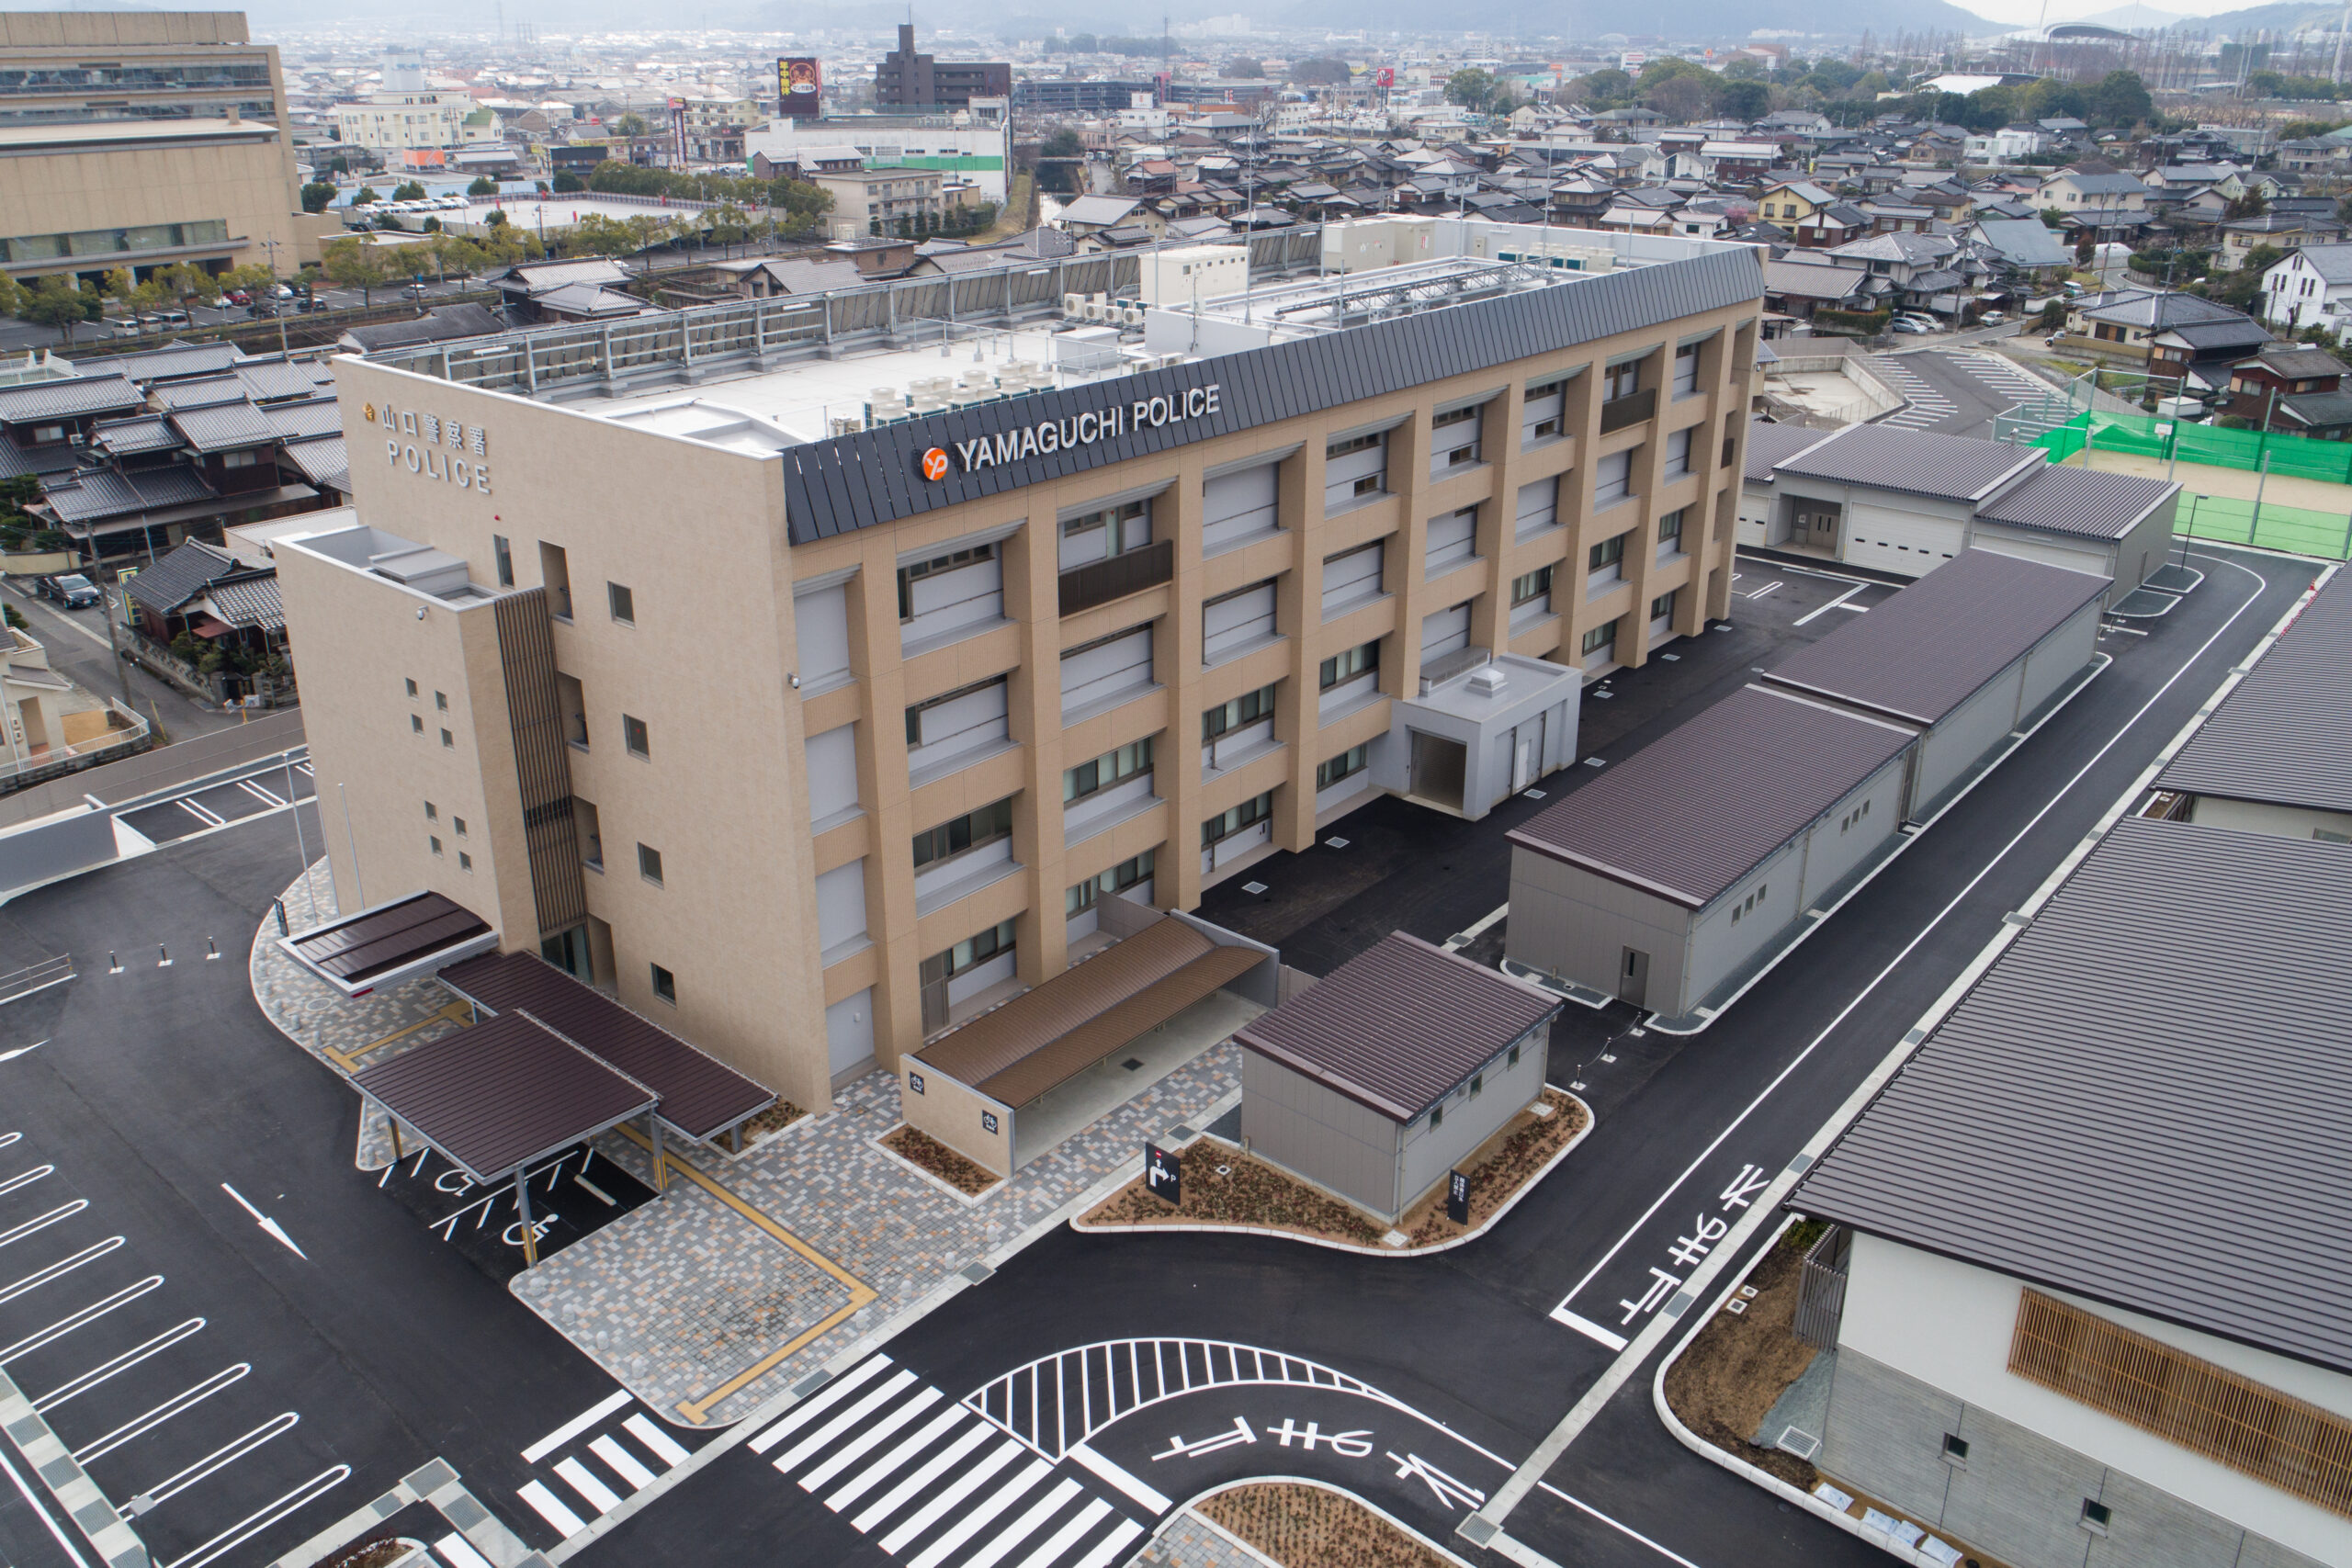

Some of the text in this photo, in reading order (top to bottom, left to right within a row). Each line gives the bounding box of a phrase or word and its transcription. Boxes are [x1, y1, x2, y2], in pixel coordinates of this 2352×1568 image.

[381, 403, 487, 457] 山口警察署
[956, 384, 1220, 473] YAMAGUCHI POLICE
[386, 438, 492, 495] POLICE
[1170, 1174, 1177, 1182] P
[1618, 1163, 1771, 1326] 止まれ
[1151, 1416, 1487, 1511] 止まれ
